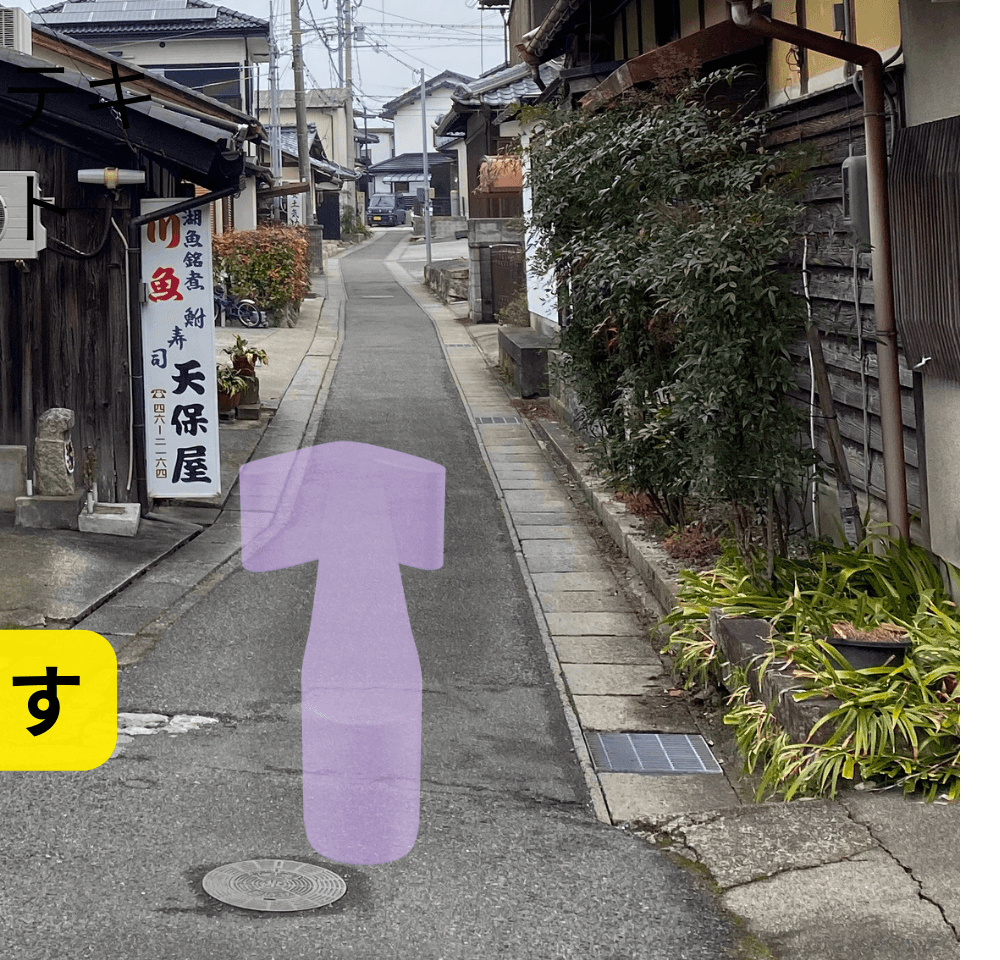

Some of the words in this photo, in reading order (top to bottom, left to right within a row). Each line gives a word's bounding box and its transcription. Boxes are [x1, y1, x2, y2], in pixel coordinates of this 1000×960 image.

[146, 214, 183, 302] 川魚
[171, 359, 212, 483] 天保屋
